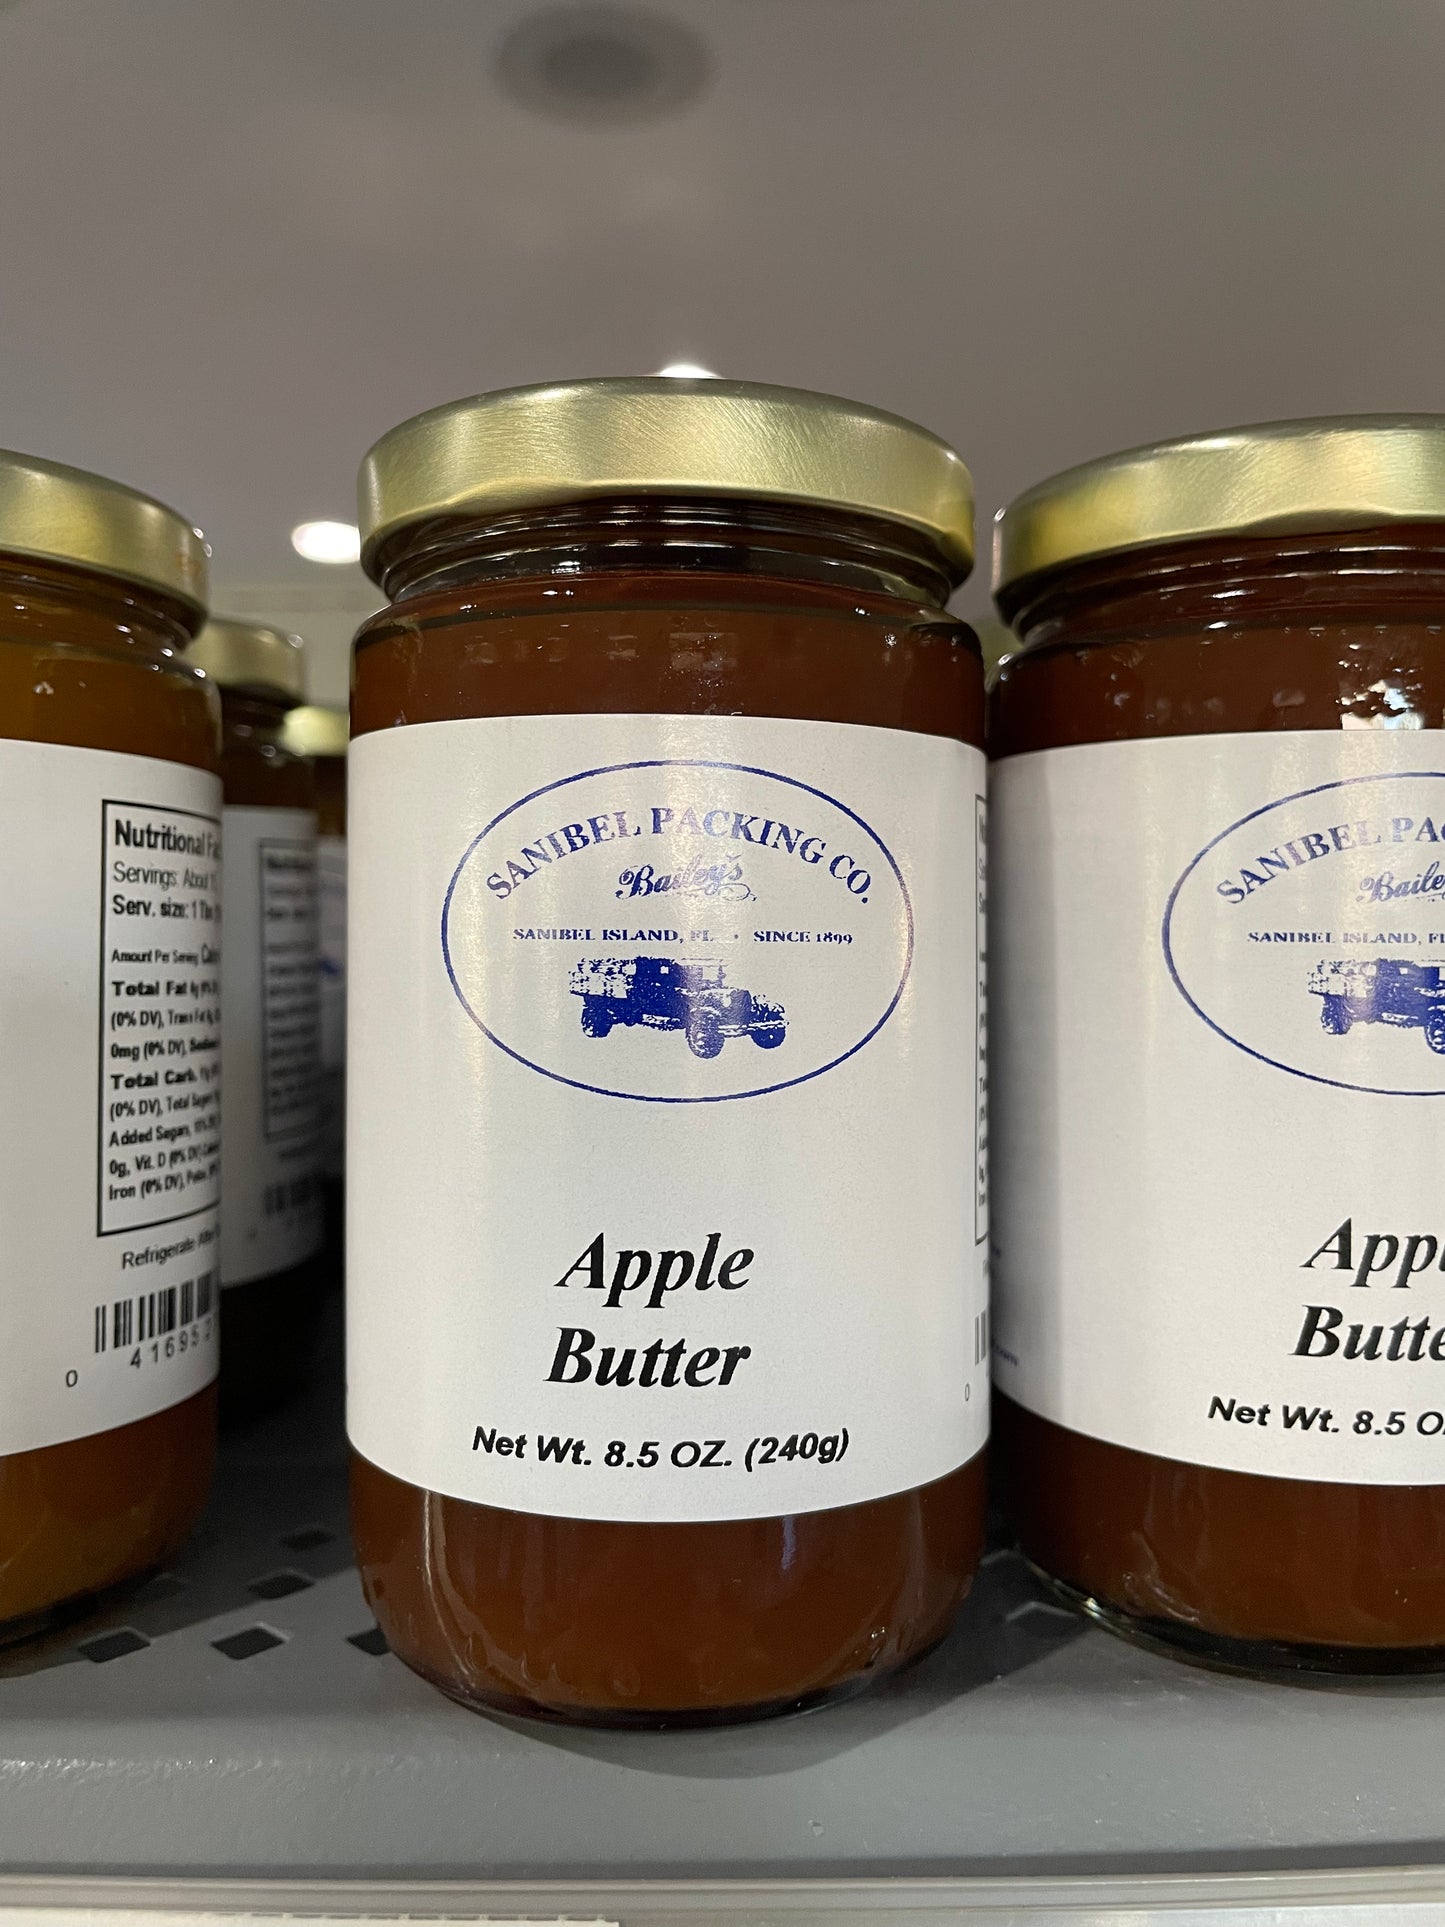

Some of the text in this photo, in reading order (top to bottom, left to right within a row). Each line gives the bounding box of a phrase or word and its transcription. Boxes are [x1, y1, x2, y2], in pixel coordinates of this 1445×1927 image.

[114, 818, 205, 856] Nutritional
[486, 807, 872, 904] SANIBEL PACKING CO.
[1216, 820, 1381, 904] SANIBEL
[615, 853, 757, 901] Bailey's
[1356, 860, 1445, 903] Baile
[113, 894, 156, 917] Serv.
[513, 928, 853, 945] SANIBEL ISLAND, FL SINCE 1899
[1247, 931, 1335, 944] SANIBEL
[1342, 932, 1421, 946] ISLAND,
[112, 948, 153, 963] Amount
[111, 980, 159, 996] Total
[111, 1010, 137, 1032] (0%
[111, 1043, 140, 1062] 0mg
[110, 1070, 159, 1090] Total
[110, 1100, 136, 1122] (0%
[109, 1126, 153, 1148] Added
[158, 1151, 166, 1168] D
[109, 1184, 136, 1200] Iron
[553, 1232, 755, 1308] Apple
[543, 1326, 752, 1388] Butter
[1207, 1395, 1445, 1436] Net Wt. 8.5 O
[472, 1426, 850, 1473] Net Wt. 8.5 OZ. (240g)
